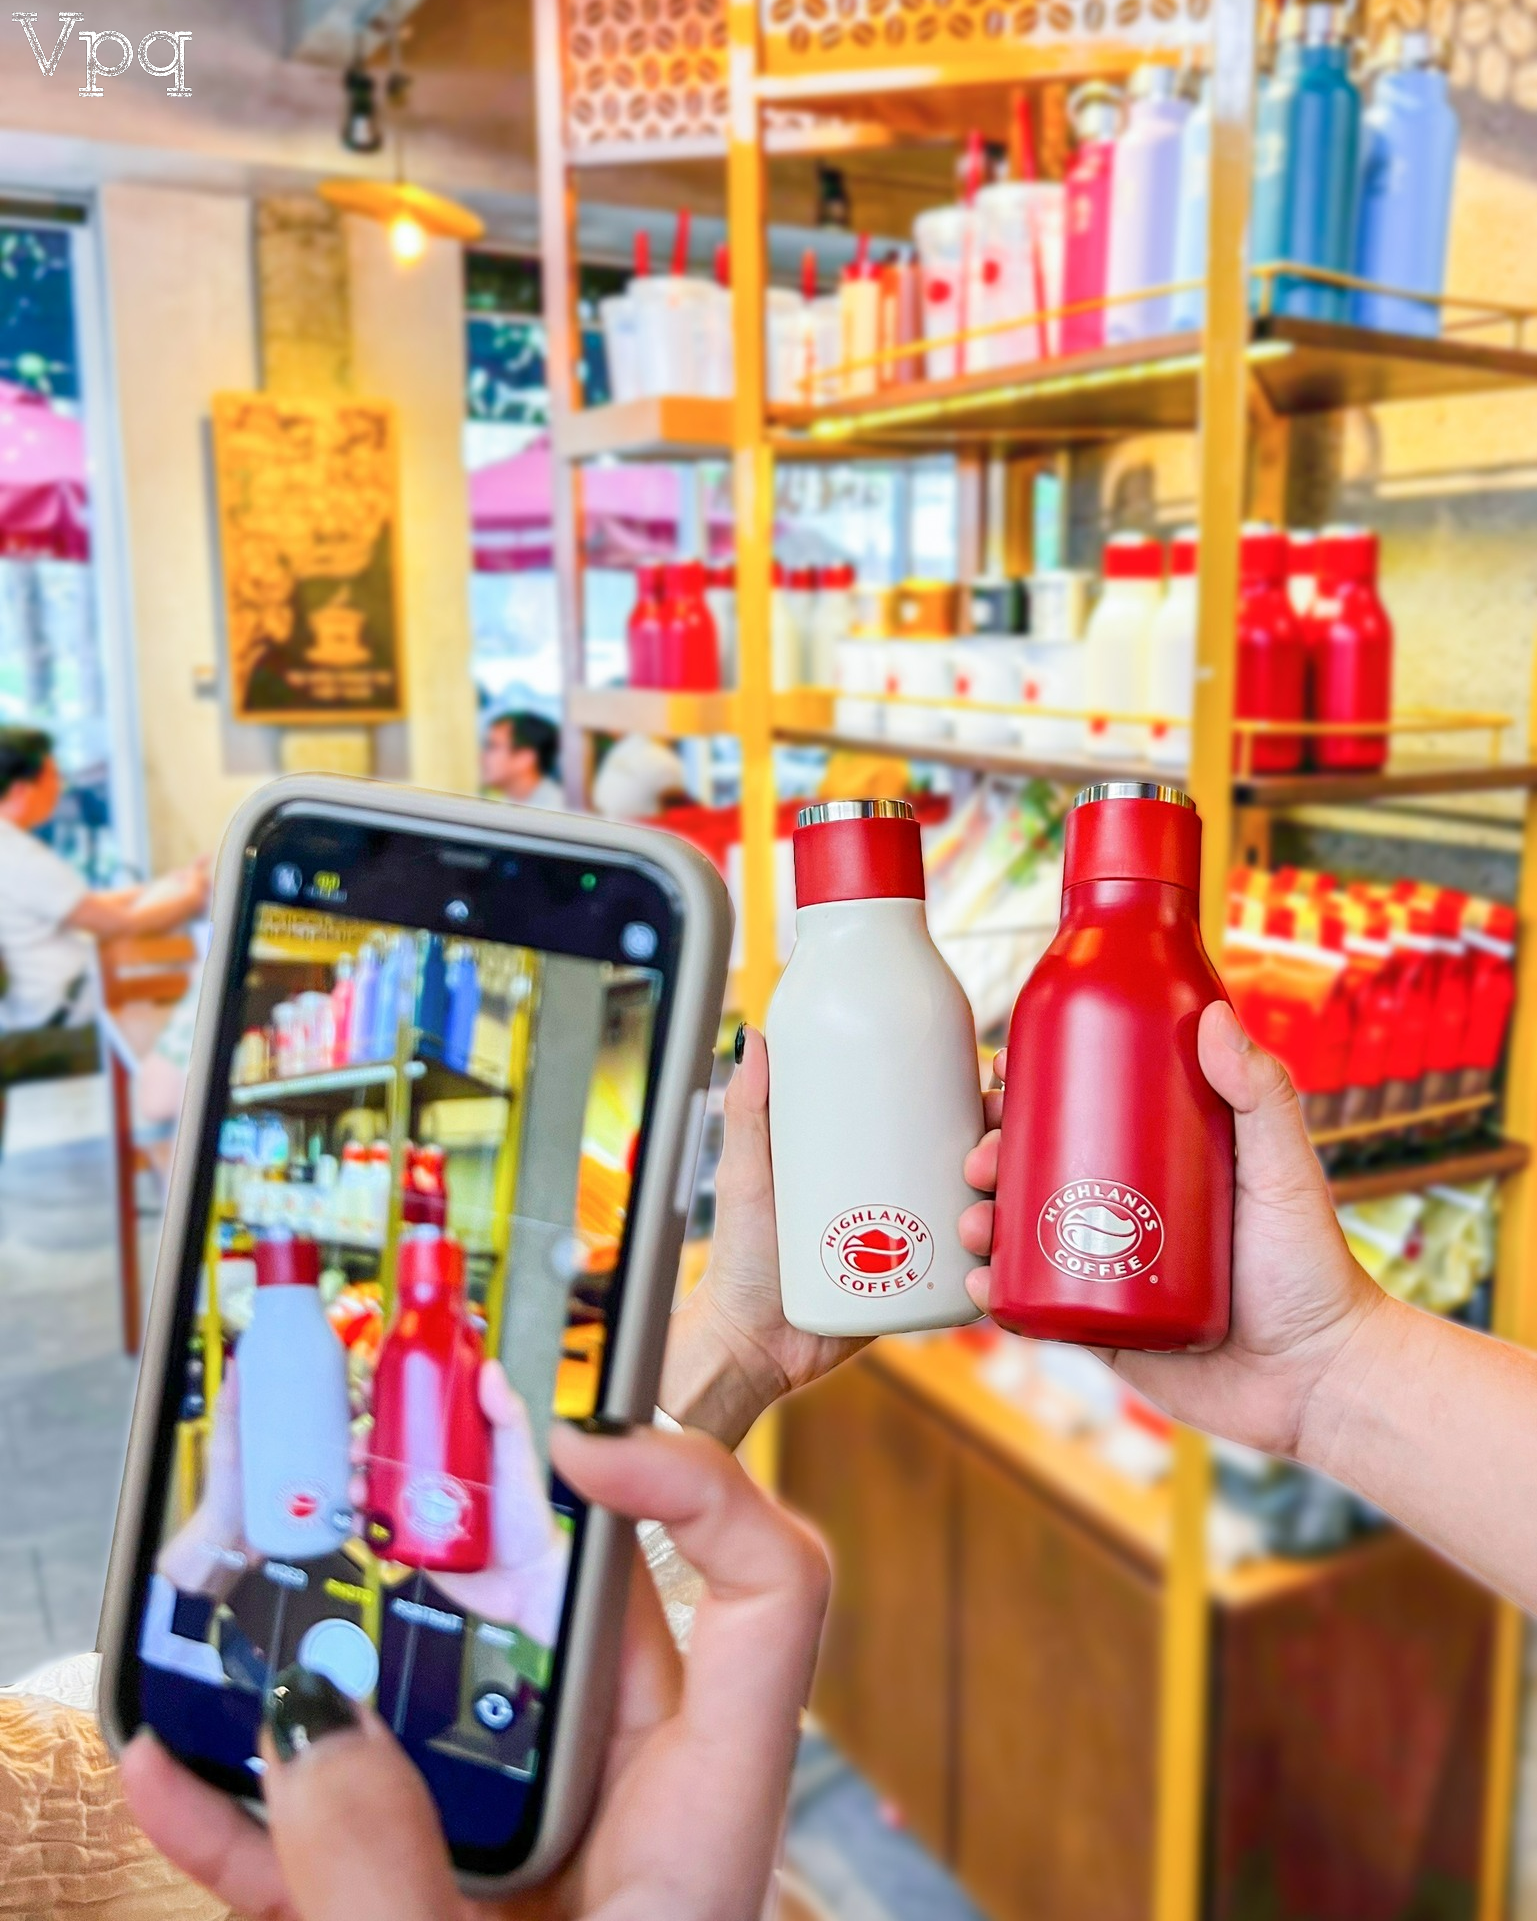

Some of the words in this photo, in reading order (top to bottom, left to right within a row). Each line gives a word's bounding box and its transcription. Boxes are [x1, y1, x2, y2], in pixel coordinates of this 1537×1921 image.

[1044, 1184, 1158, 1231] HIGHLANDS
[826, 1210, 927, 1248] HIGHLANDS
[1054, 1249, 1143, 1277] COFFEE
[839, 1268, 918, 1293] COFFEE
